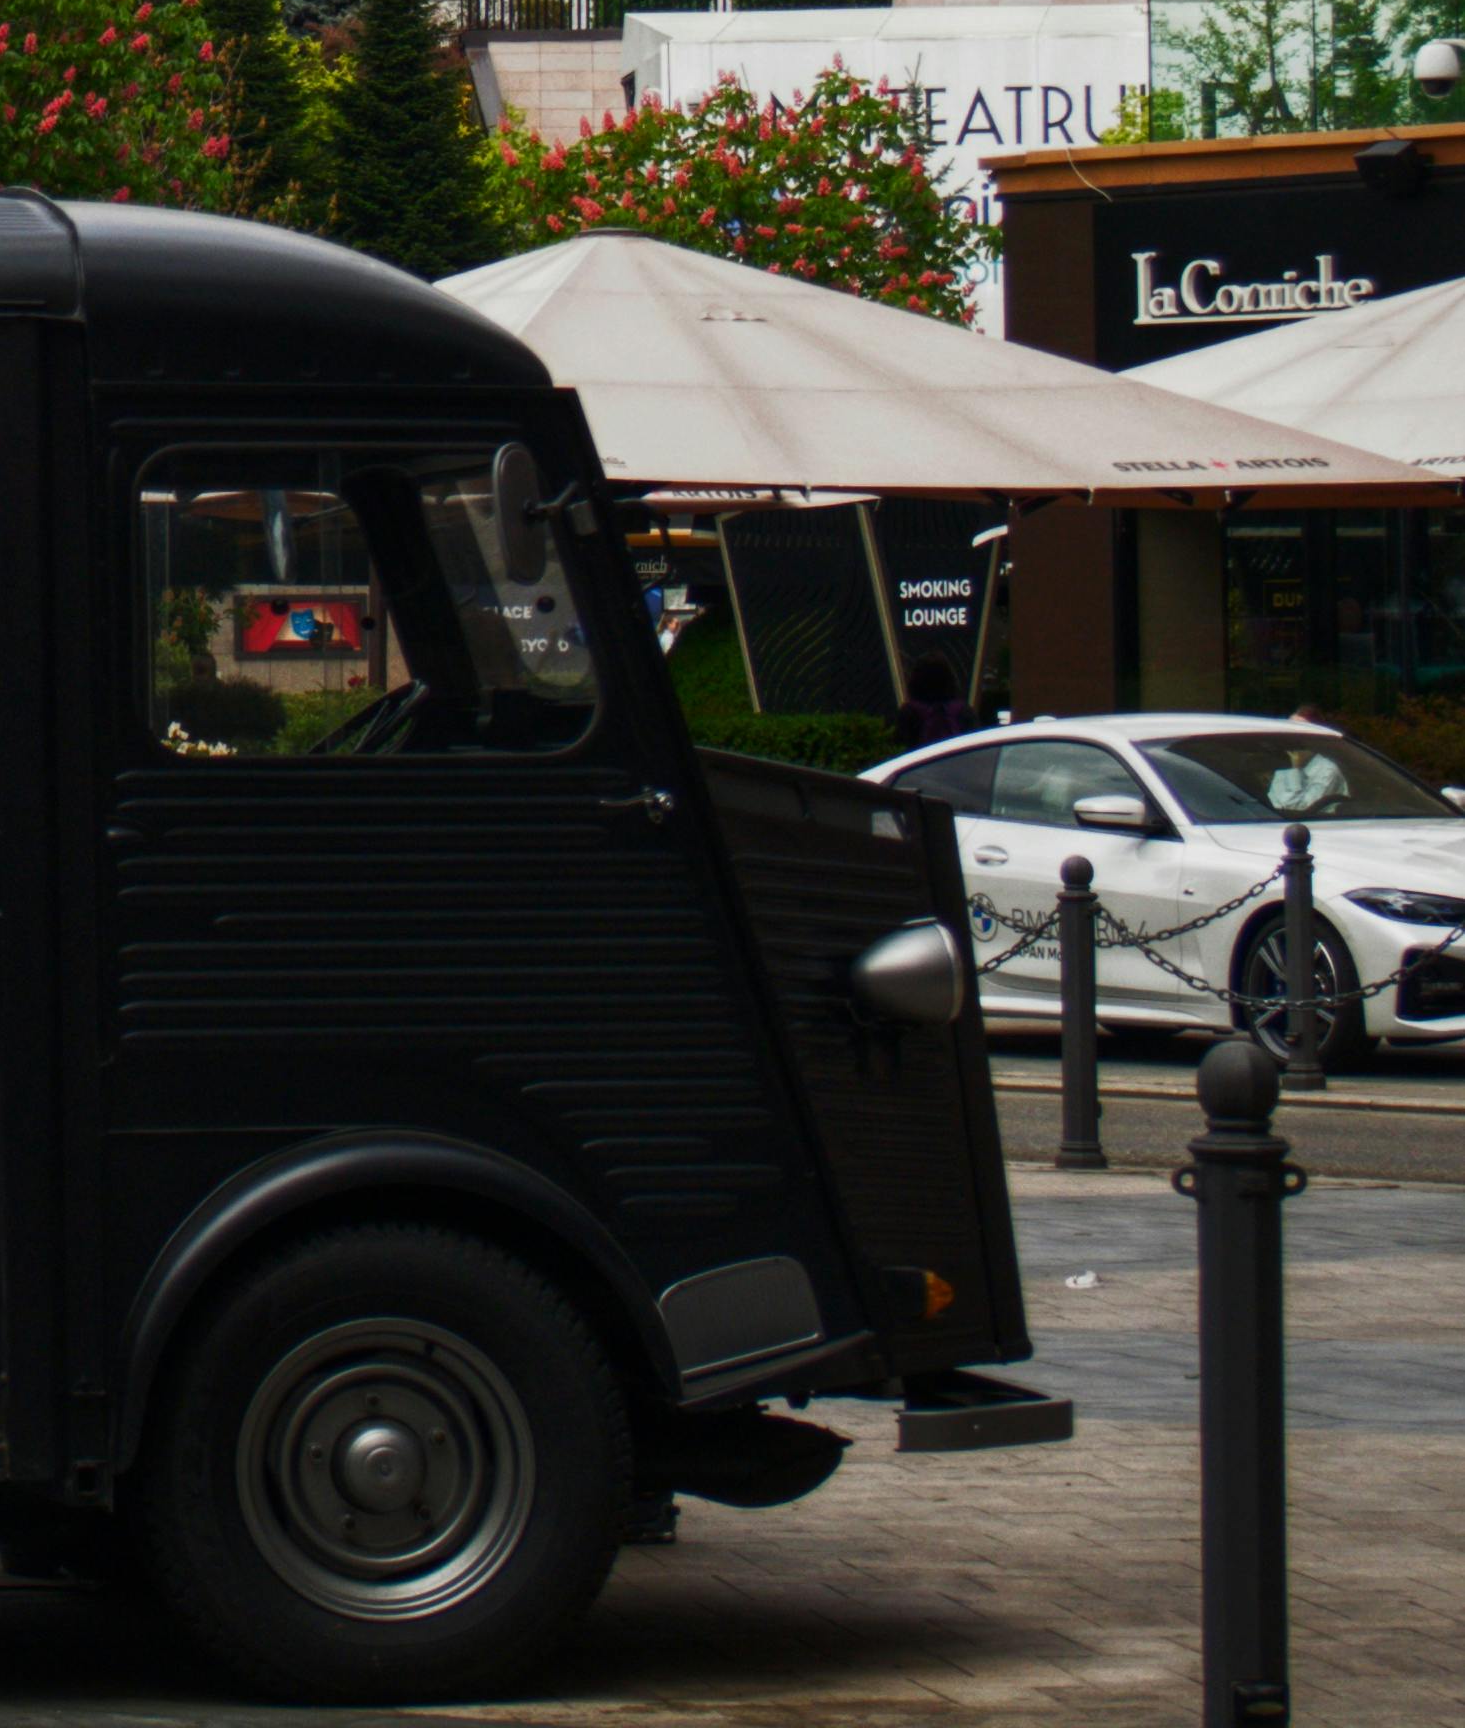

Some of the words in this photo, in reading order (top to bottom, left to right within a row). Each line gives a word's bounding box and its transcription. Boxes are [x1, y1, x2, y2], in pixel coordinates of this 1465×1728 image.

[1112, 460, 1207, 473] STELLA
[1235, 455, 1331, 470] ARTOIS
[899, 579, 971, 599] SMOKING
[904, 607, 967, 626] LOUNGE
